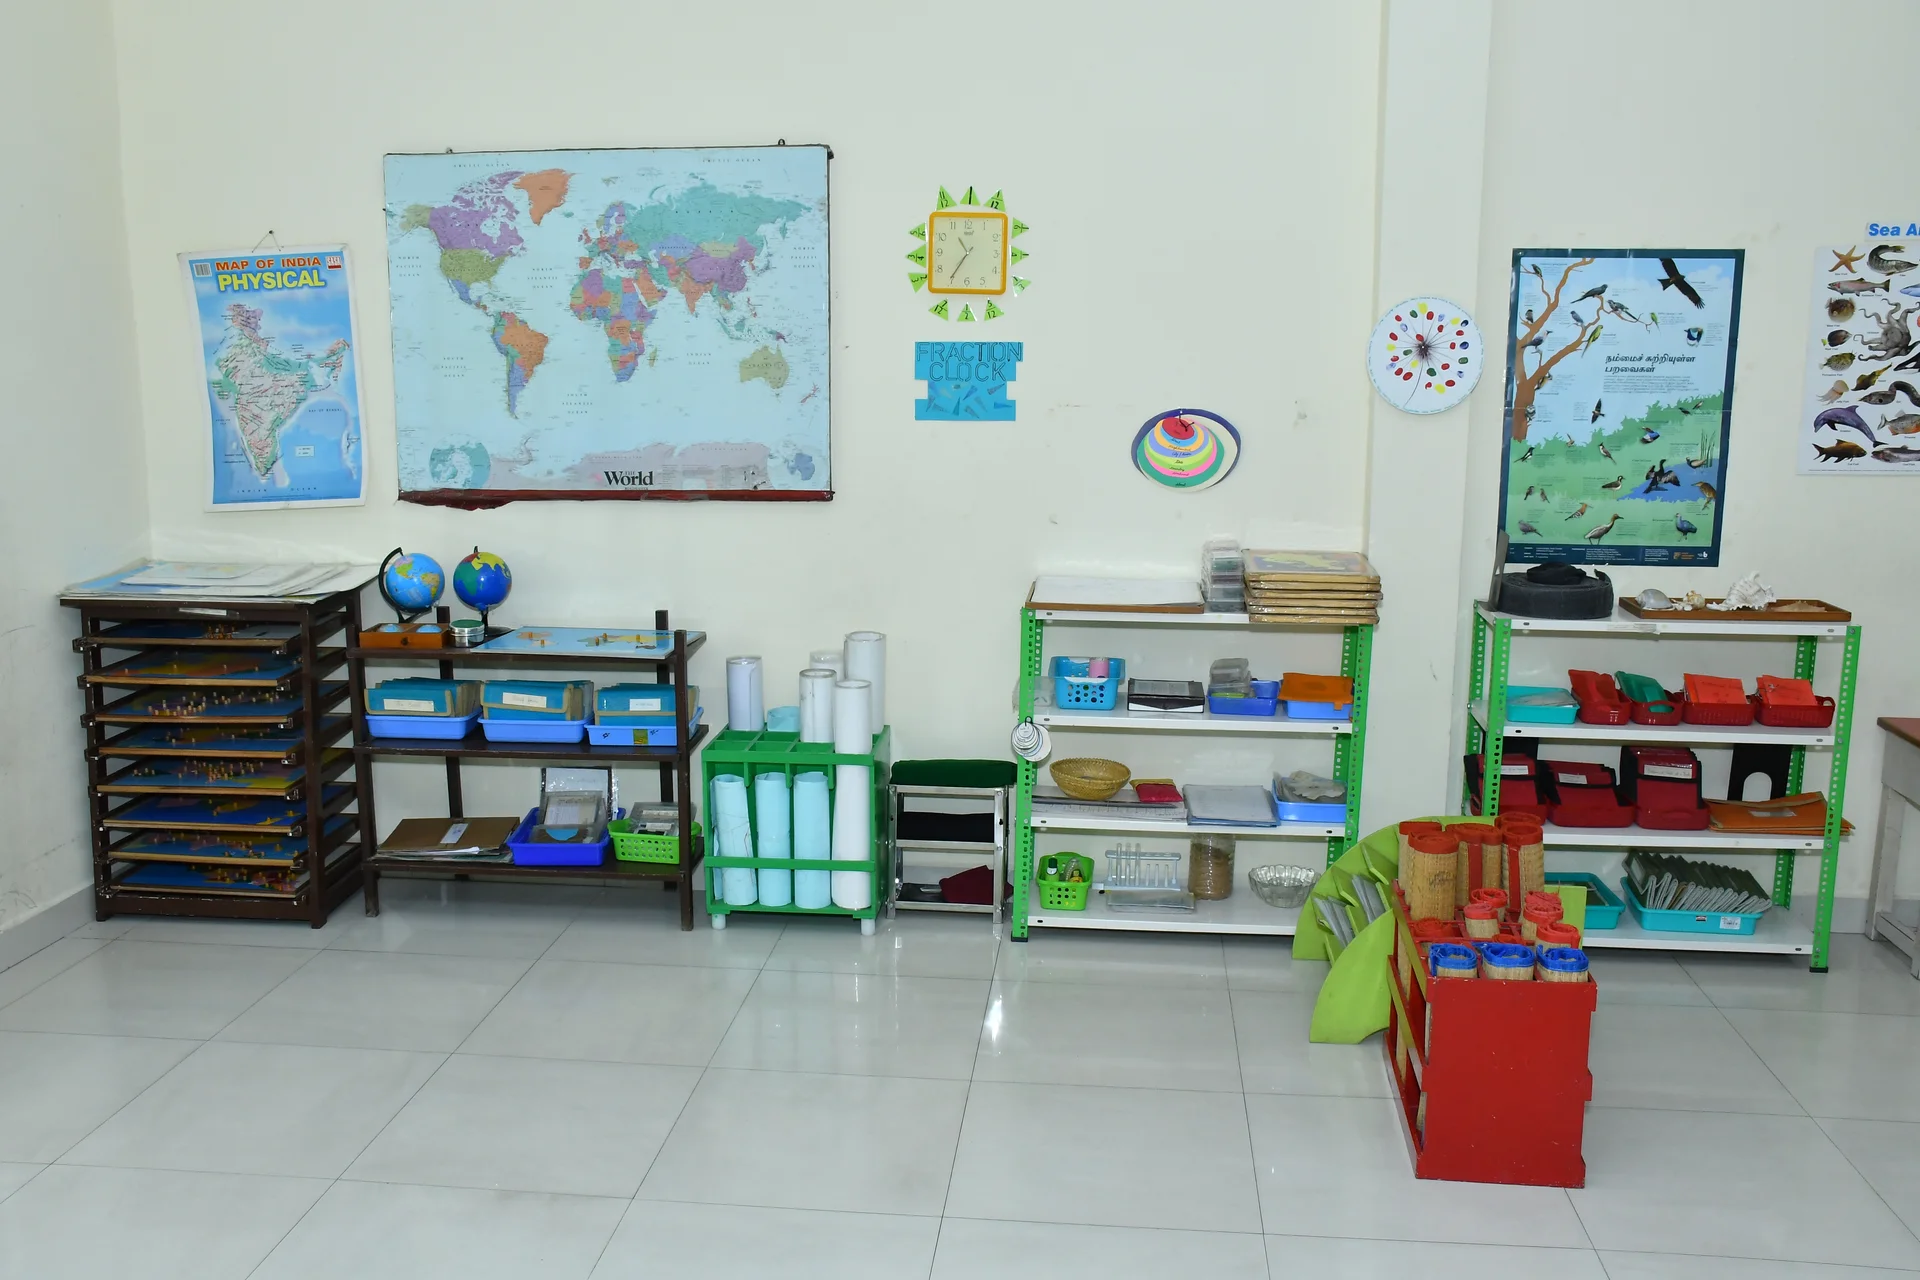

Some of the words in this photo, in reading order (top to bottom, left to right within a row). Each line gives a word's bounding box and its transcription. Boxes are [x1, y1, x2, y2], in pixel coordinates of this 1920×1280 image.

[990, 200, 1000, 210] 12
[950, 221, 956, 230] 11
[964, 220, 973, 230] 12
[1869, 223, 1900, 236] Sea
[1906, 223, 1920, 236] A
[938, 232, 947, 242] 10
[992, 234, 999, 242] 2
[936, 248, 944, 256] 9
[992, 249, 999, 258] 3
[216, 260, 249, 271] MAP
[256, 258, 275, 268] OF
[282, 257, 322, 268] INDIA
[936, 264, 944, 274] 8
[992, 266, 998, 275] 4
[218, 270, 326, 291] PHYSICAL
[964, 276, 970, 286] 6
[980, 276, 986, 286] 5
[987, 311, 998, 319] 12
[916, 342, 1022, 362] FRACTION
[1605, 353, 1644, 364] நம்மைச்
[1645, 353, 1696, 364] சுற்றியுள்ள
[929, 362, 1007, 382] CLOCK
[1604, 364, 1656, 374] பறவைகள்
[604, 471, 654, 486] World
